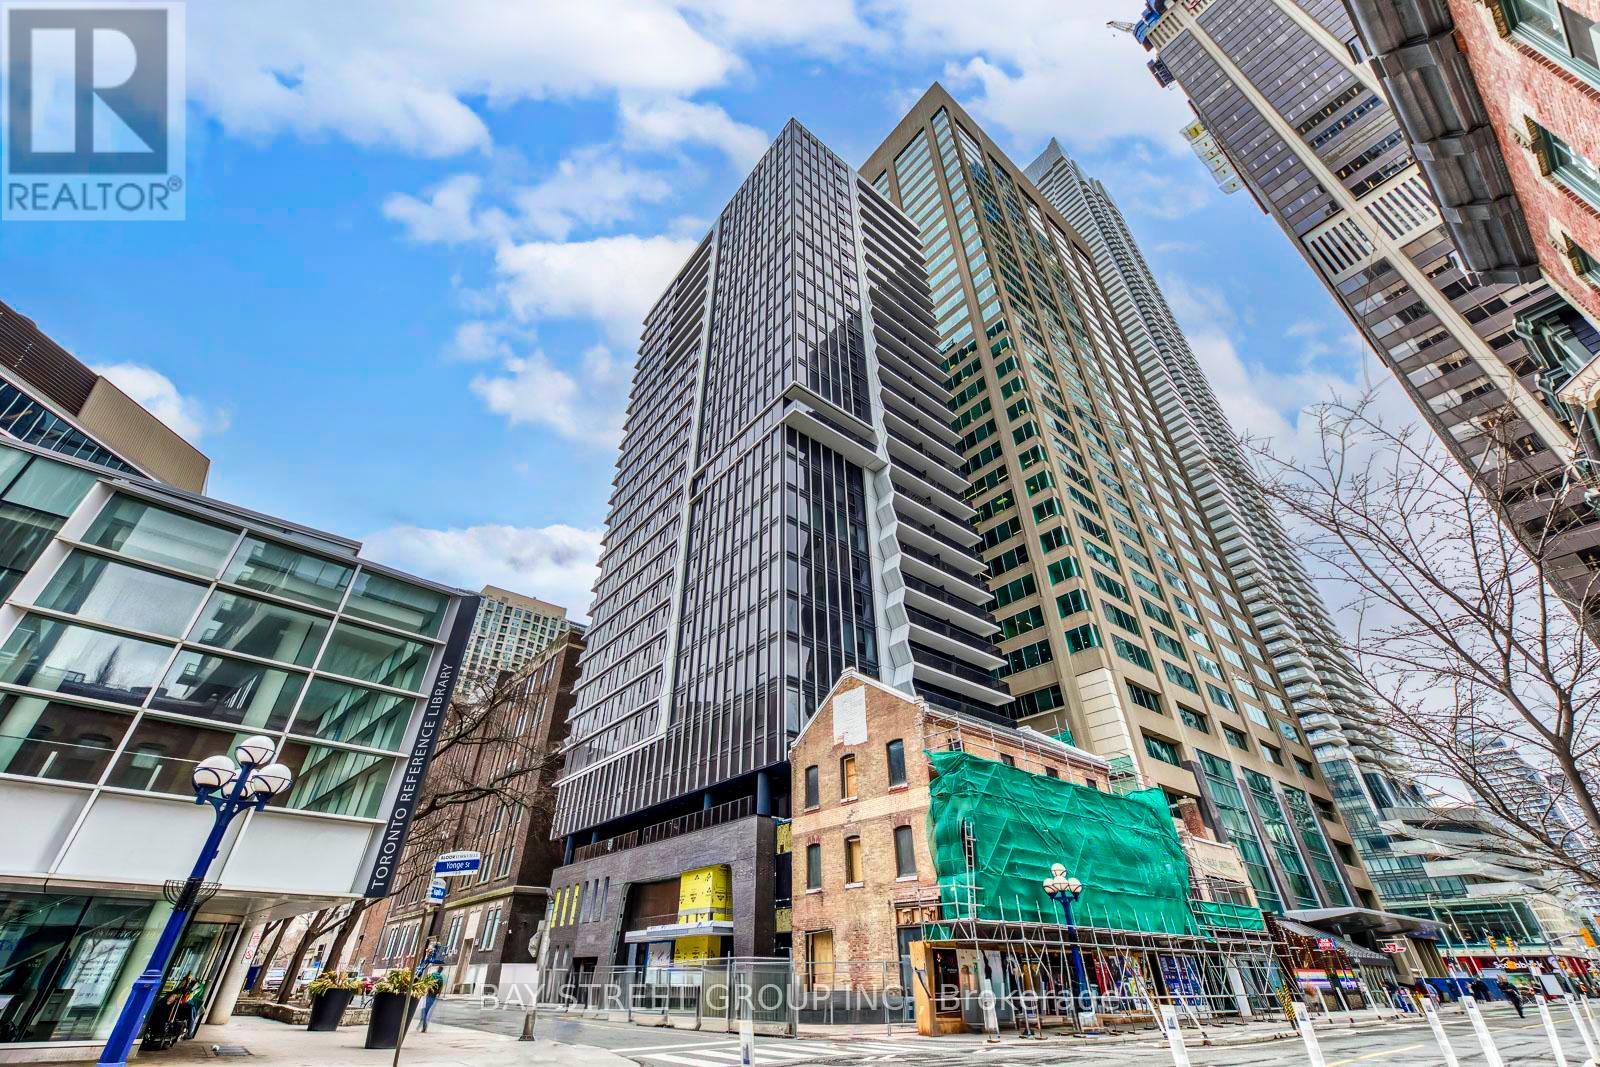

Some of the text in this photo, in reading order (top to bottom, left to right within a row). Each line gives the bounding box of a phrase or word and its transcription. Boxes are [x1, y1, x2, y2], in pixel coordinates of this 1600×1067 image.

[372, 664, 453, 889] TORONTO REFERENCE LIBRARY
[446, 861, 464, 870] Yonge
